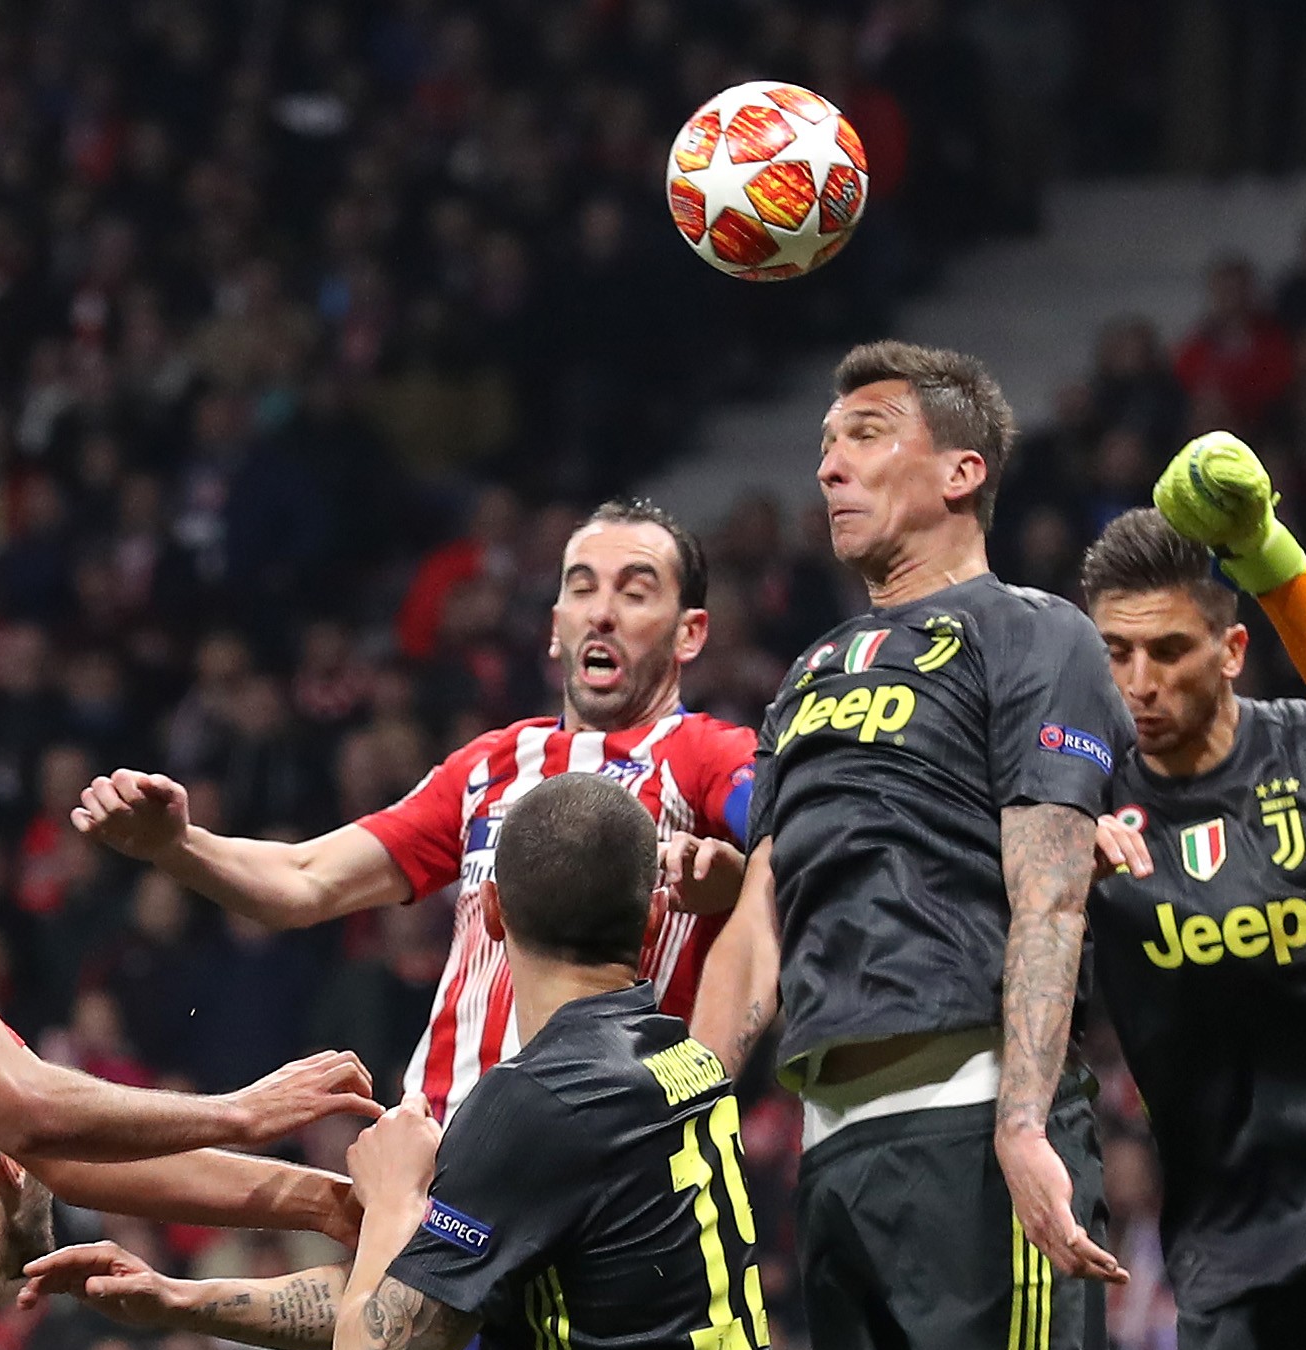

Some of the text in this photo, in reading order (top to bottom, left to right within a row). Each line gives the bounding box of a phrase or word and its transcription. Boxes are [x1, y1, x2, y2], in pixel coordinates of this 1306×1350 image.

[775, 685, 916, 756] Jeep
[1064, 733, 1112, 769] RESPECT
[429, 1209, 489, 1248] RESPECT
